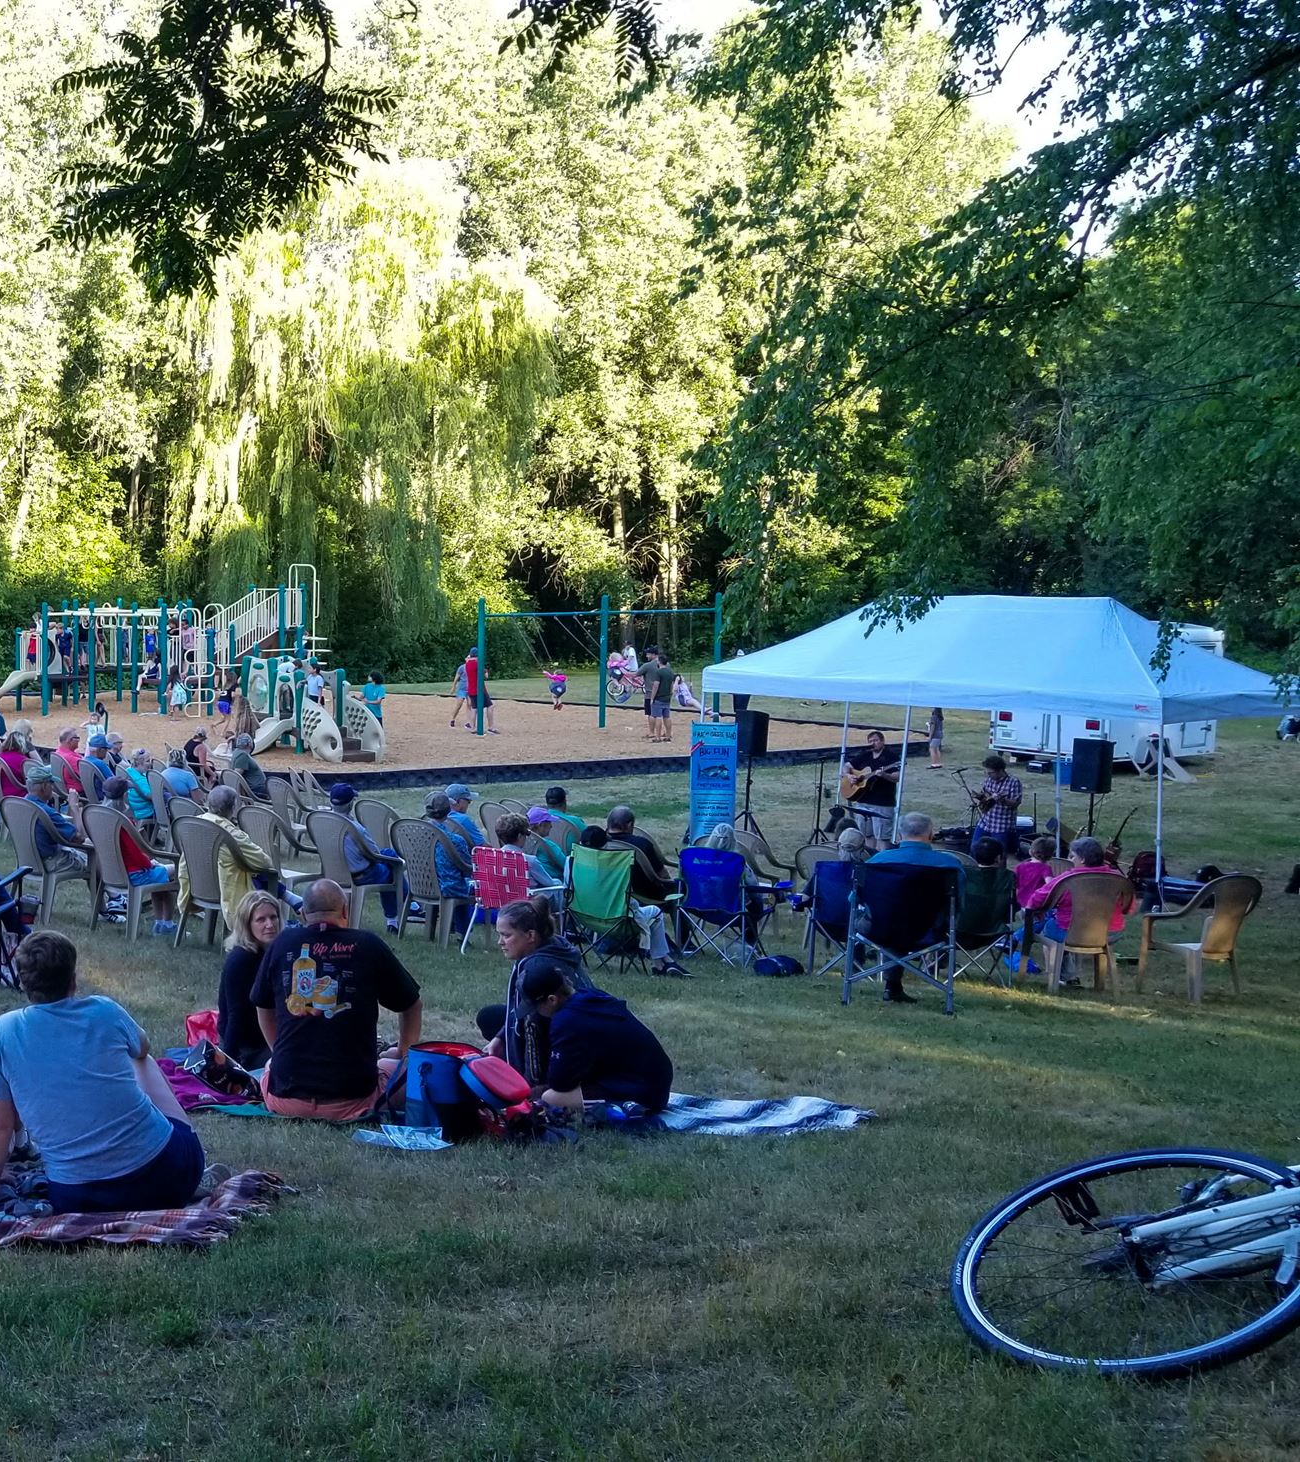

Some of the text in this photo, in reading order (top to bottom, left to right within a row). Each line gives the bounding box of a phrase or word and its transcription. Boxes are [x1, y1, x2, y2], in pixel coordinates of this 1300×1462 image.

[699, 746, 730, 757] BIG FUN
[313, 943, 328, 956] Up
[955, 1262, 963, 1285] GIANT
